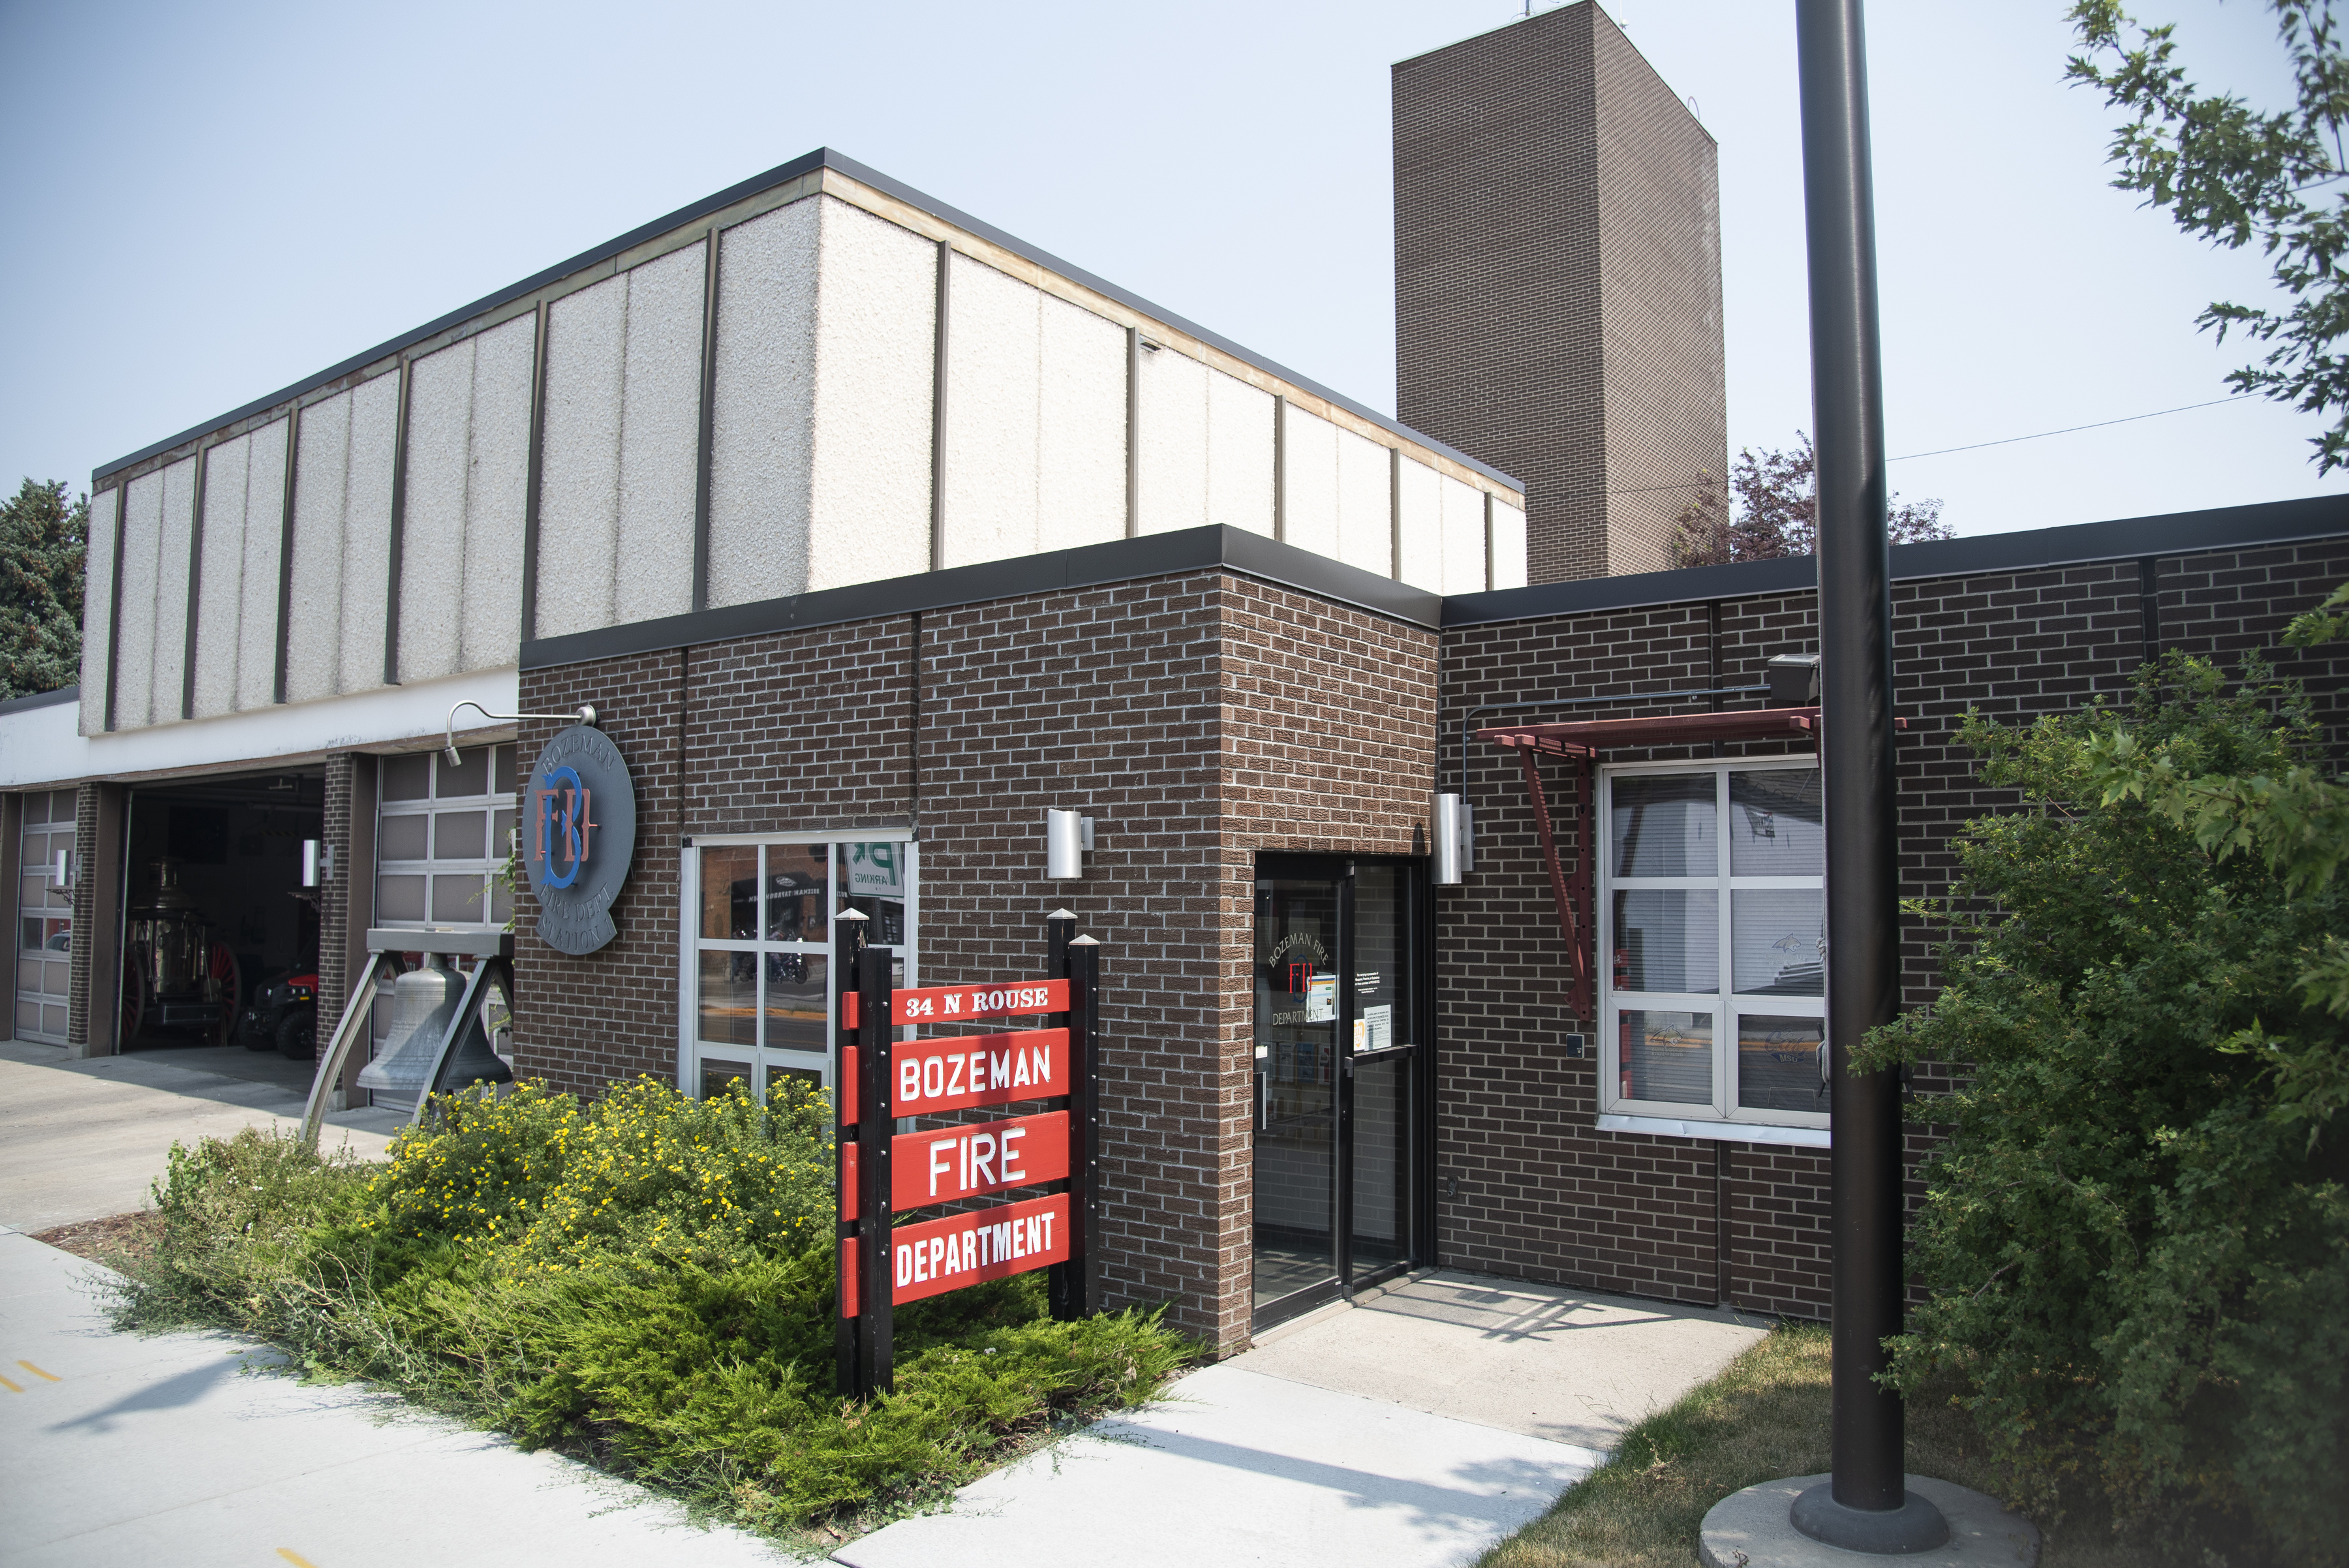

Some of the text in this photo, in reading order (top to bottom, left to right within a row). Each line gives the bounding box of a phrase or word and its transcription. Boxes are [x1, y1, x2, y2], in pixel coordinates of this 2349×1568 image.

[541, 734, 616, 775] BOZEMAN
[540, 882, 614, 922] FIRE DEPT.
[539, 916, 613, 951] STATION 1
[1268, 932, 1329, 968] BOZEMAN FIRE
[906, 997, 934, 1017] 34
[971, 987, 1049, 1011] ROUSE
[1272, 1008, 1324, 1026] DEPARTMENT
[899, 1045, 1051, 1102] BOZEMAN
[1779, 1054, 1798, 1062] MSU
[929, 1127, 1026, 1197] FIRE
[896, 1211, 1056, 1288] DEPARTMENT
